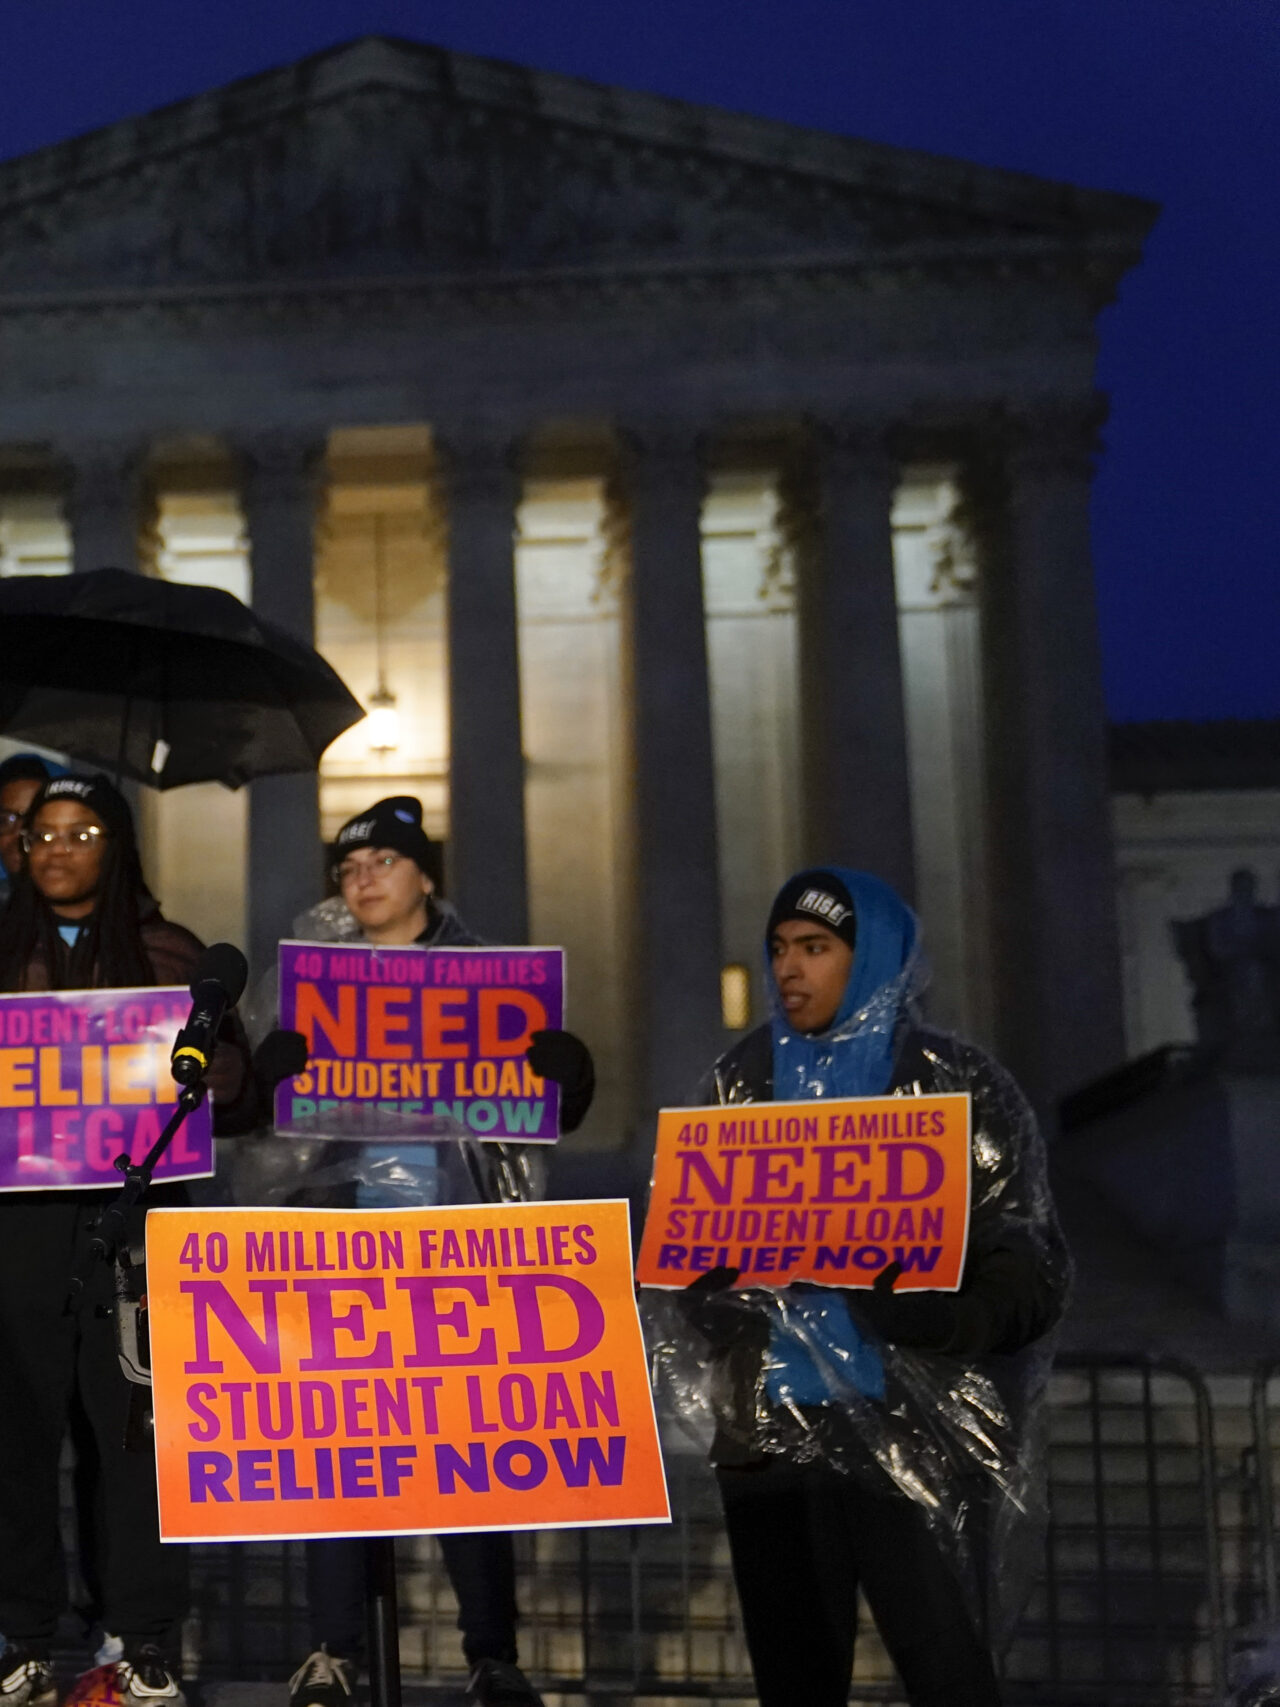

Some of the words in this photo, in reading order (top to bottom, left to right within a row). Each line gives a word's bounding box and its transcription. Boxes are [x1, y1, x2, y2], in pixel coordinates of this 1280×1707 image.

[801, 890, 845, 921] RISE
[294, 954, 323, 979] 40
[330, 956, 425, 984] MILLION
[433, 957, 547, 985] FAMILIES
[295, 982, 548, 1059] NEED
[292, 1059, 443, 1098] STUDENT
[454, 1060, 545, 1098] LOAN
[433, 1100, 545, 1133] NOW
[677, 1123, 709, 1147] 40
[718, 1116, 818, 1146] MILLION
[829, 1110, 946, 1140] FAMILIES
[18, 1108, 200, 1173] LEGAL
[670, 1142, 946, 1205] NEED
[665, 1208, 832, 1242] STUDENT
[845, 1207, 944, 1242] LOAN
[179, 1231, 229, 1274] 40
[245, 1230, 405, 1273] MILLION
[420, 1224, 597, 1270] FAMILIES
[812, 1245, 943, 1272] NOW
[180, 1273, 606, 1375] NEED
[186, 1376, 443, 1443] STUDENT
[465, 1370, 621, 1434] LOAN
[187, 1445, 418, 1504] RELIEF
[434, 1436, 626, 1495] NOW
